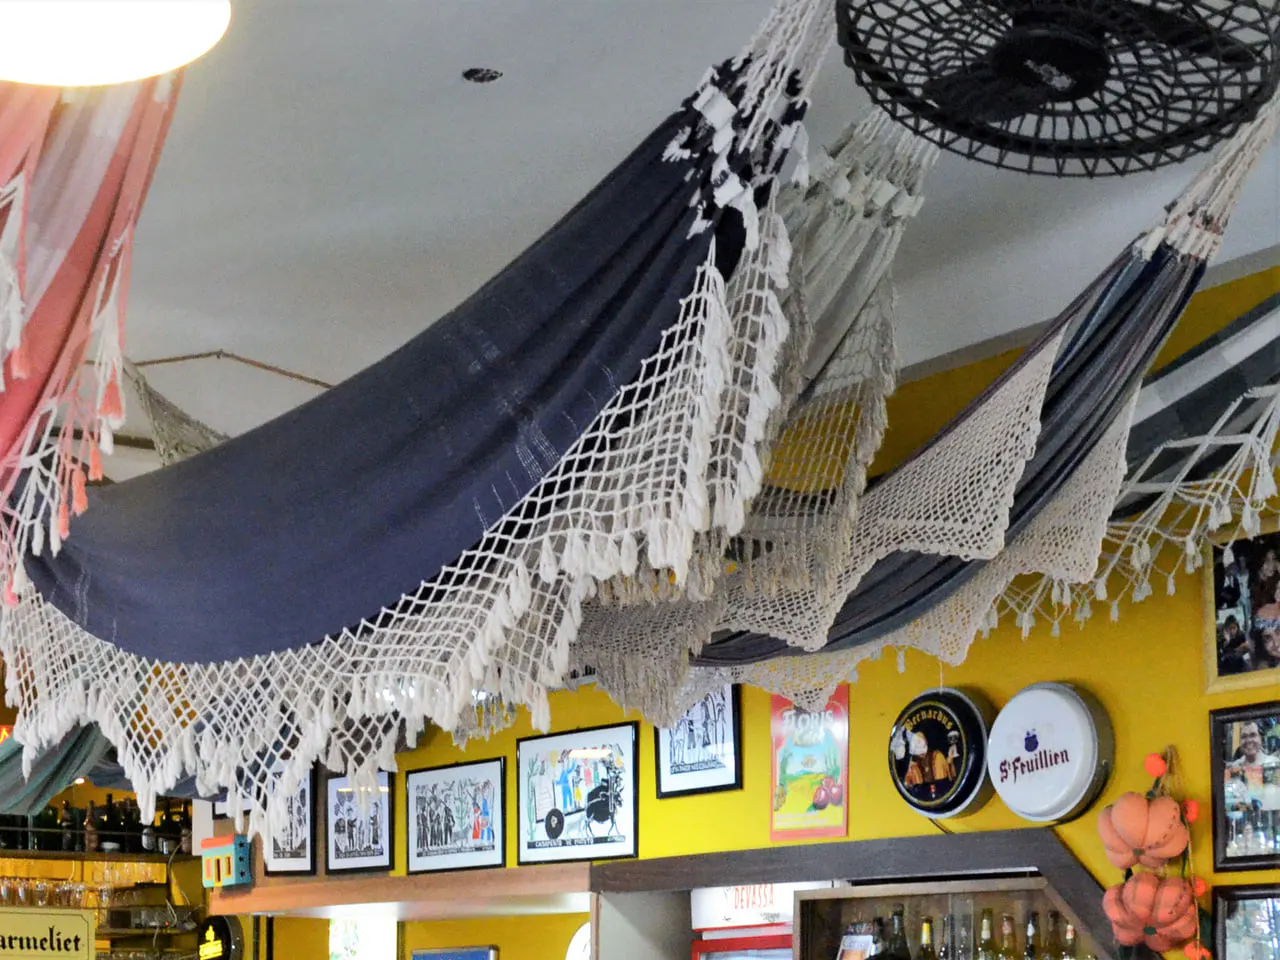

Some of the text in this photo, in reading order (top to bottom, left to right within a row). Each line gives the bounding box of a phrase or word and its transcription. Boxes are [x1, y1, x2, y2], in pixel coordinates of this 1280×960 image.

[904, 709, 953, 731] Bernardus
[1012, 749, 1070, 784] Feuillien
[734, 883, 774, 909] DEVASSA
